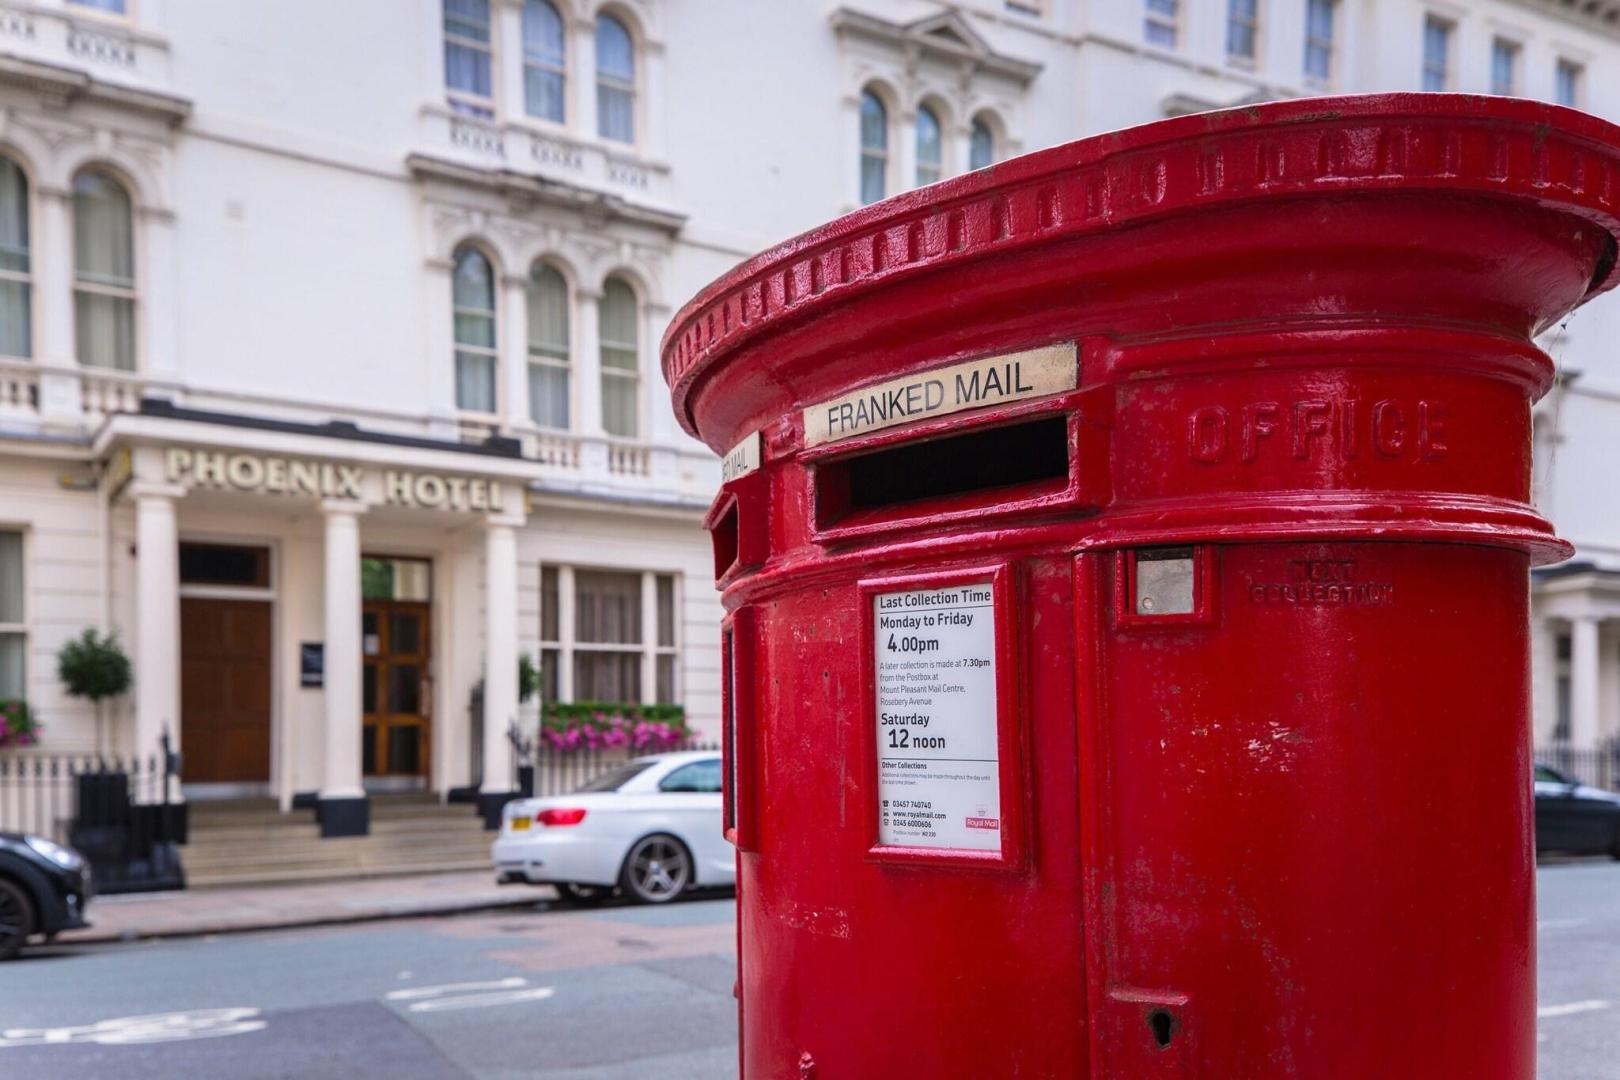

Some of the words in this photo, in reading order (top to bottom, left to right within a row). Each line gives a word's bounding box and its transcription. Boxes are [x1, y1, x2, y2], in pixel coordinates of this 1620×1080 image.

[828, 377, 945, 435] FRANKED
[955, 360, 1033, 405] MAIL
[1187, 399, 1448, 464] OFFICE
[166, 448, 364, 499] PHOENIX
[386, 471, 504, 513] HOTEL
[880, 596, 903, 609] Last
[905, 592, 958, 607] Collection
[961, 589, 991, 603] Time
[880, 615, 921, 630] Monday
[924, 615, 935, 626] to
[938, 612, 974, 627] Friday
[888, 633, 939, 654] 4.00pm
[880, 662, 885, 670] A
[885, 662, 899, 670] later
[900, 661, 929, 669] collection
[930, 661, 935, 669] is
[936, 660, 954, 668] made
[955, 660, 962, 668] at
[963, 658, 991, 669] 7.30pm
[880, 673, 895, 682] from
[895, 673, 906, 681] the
[906, 673, 931, 681] Postbox
[932, 673, 938, 681] at
[880, 686, 900, 694] Mount
[901, 685, 927, 694] Pleasant
[928, 684, 941, 693] Mail
[880, 698, 909, 707] Rosebery
[909, 697, 932, 706] Avenue
[881, 713, 930, 728] Saturday
[888, 728, 909, 748] 12
[913, 736, 946, 749] noon
[881, 761, 897, 769] Other
[897, 761, 927, 770] Collections
[892, 800, 910, 808] 03457
[910, 801, 932, 809] 740740
[893, 811, 947, 820] www.royalmail.com
[893, 819, 907, 827] 0345
[907, 820, 932, 828] 6000606
[967, 818, 983, 827] Royal
[984, 819, 998, 828] Mail
